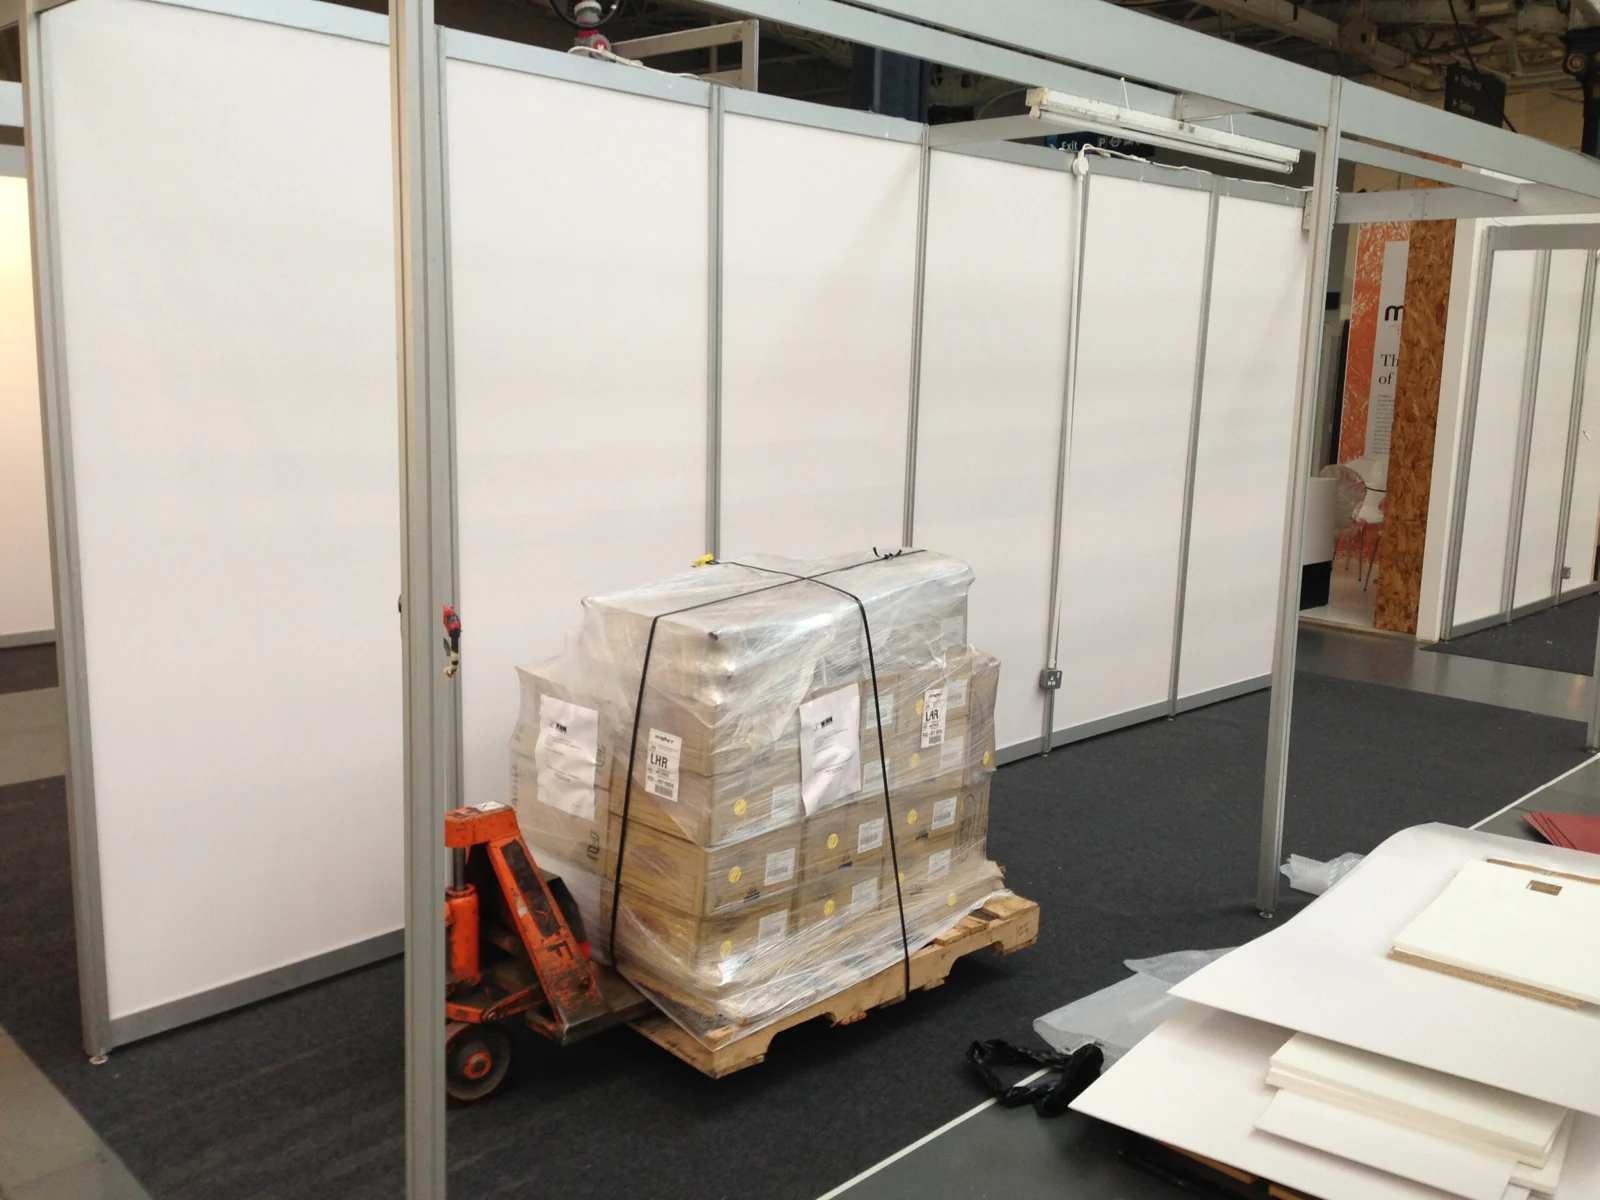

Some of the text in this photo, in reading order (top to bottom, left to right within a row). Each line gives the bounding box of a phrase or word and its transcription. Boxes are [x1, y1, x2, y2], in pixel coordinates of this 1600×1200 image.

[1061, 140, 1078, 150] Exit
[1378, 371, 1395, 385] of
[650, 753, 668, 769] LHR
